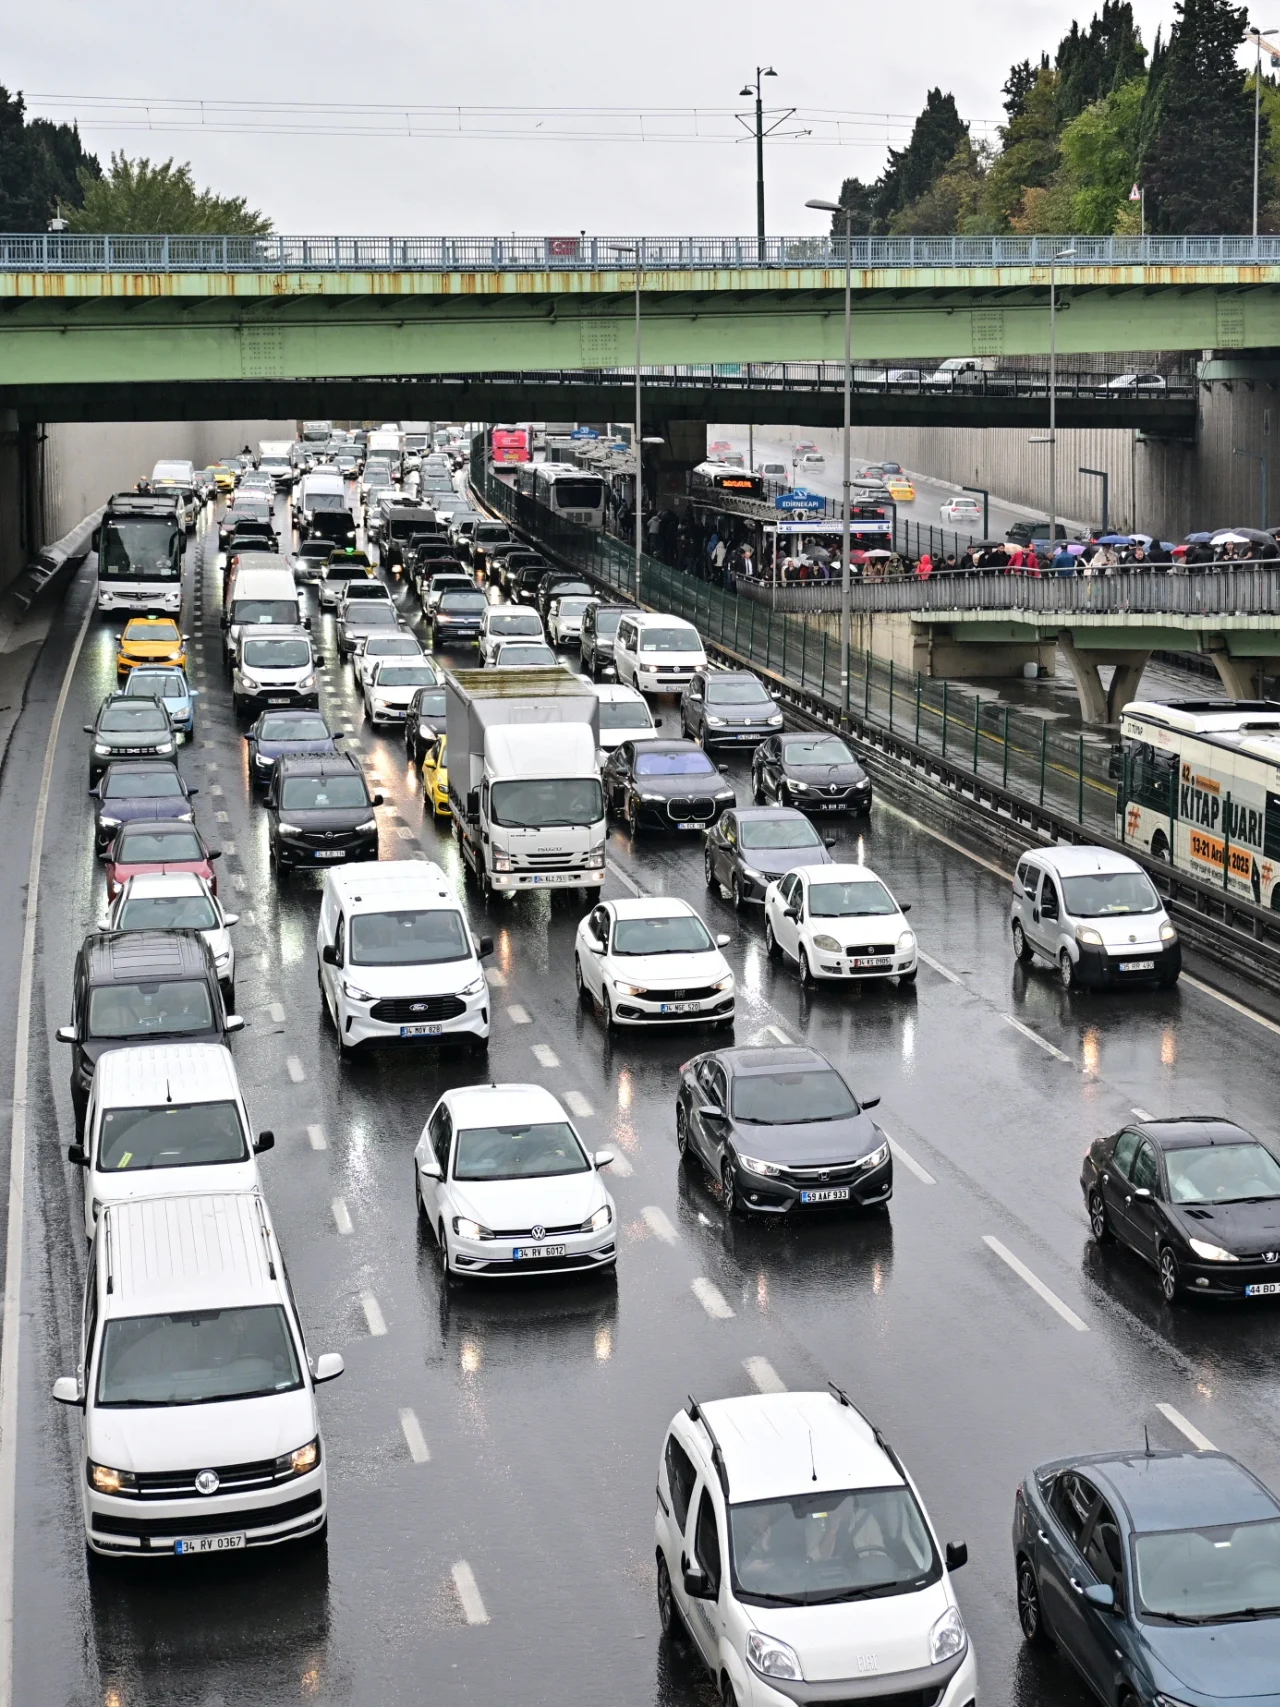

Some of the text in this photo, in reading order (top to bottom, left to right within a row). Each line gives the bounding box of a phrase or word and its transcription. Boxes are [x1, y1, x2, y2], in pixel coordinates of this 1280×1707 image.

[782, 499, 818, 508] EDİRNEKAPI
[1181, 764, 1191, 782] 42
[1180, 776, 1220, 829] KİTAP
[1192, 837, 1210, 857] 13-21
[1232, 853, 1249, 874] 2025
[674, 990, 686, 999] FIAT
[807, 1190, 847, 1201] 59 AAF 933
[532, 1248, 541, 1256] RV
[546, 1246, 564, 1255] 6012
[1250, 1285, 1260, 1293] 44
[1263, 1284, 1276, 1293] BD
[183, 1536, 242, 1552] 34 RV 0367
[857, 1654, 878, 1672] FIAT
